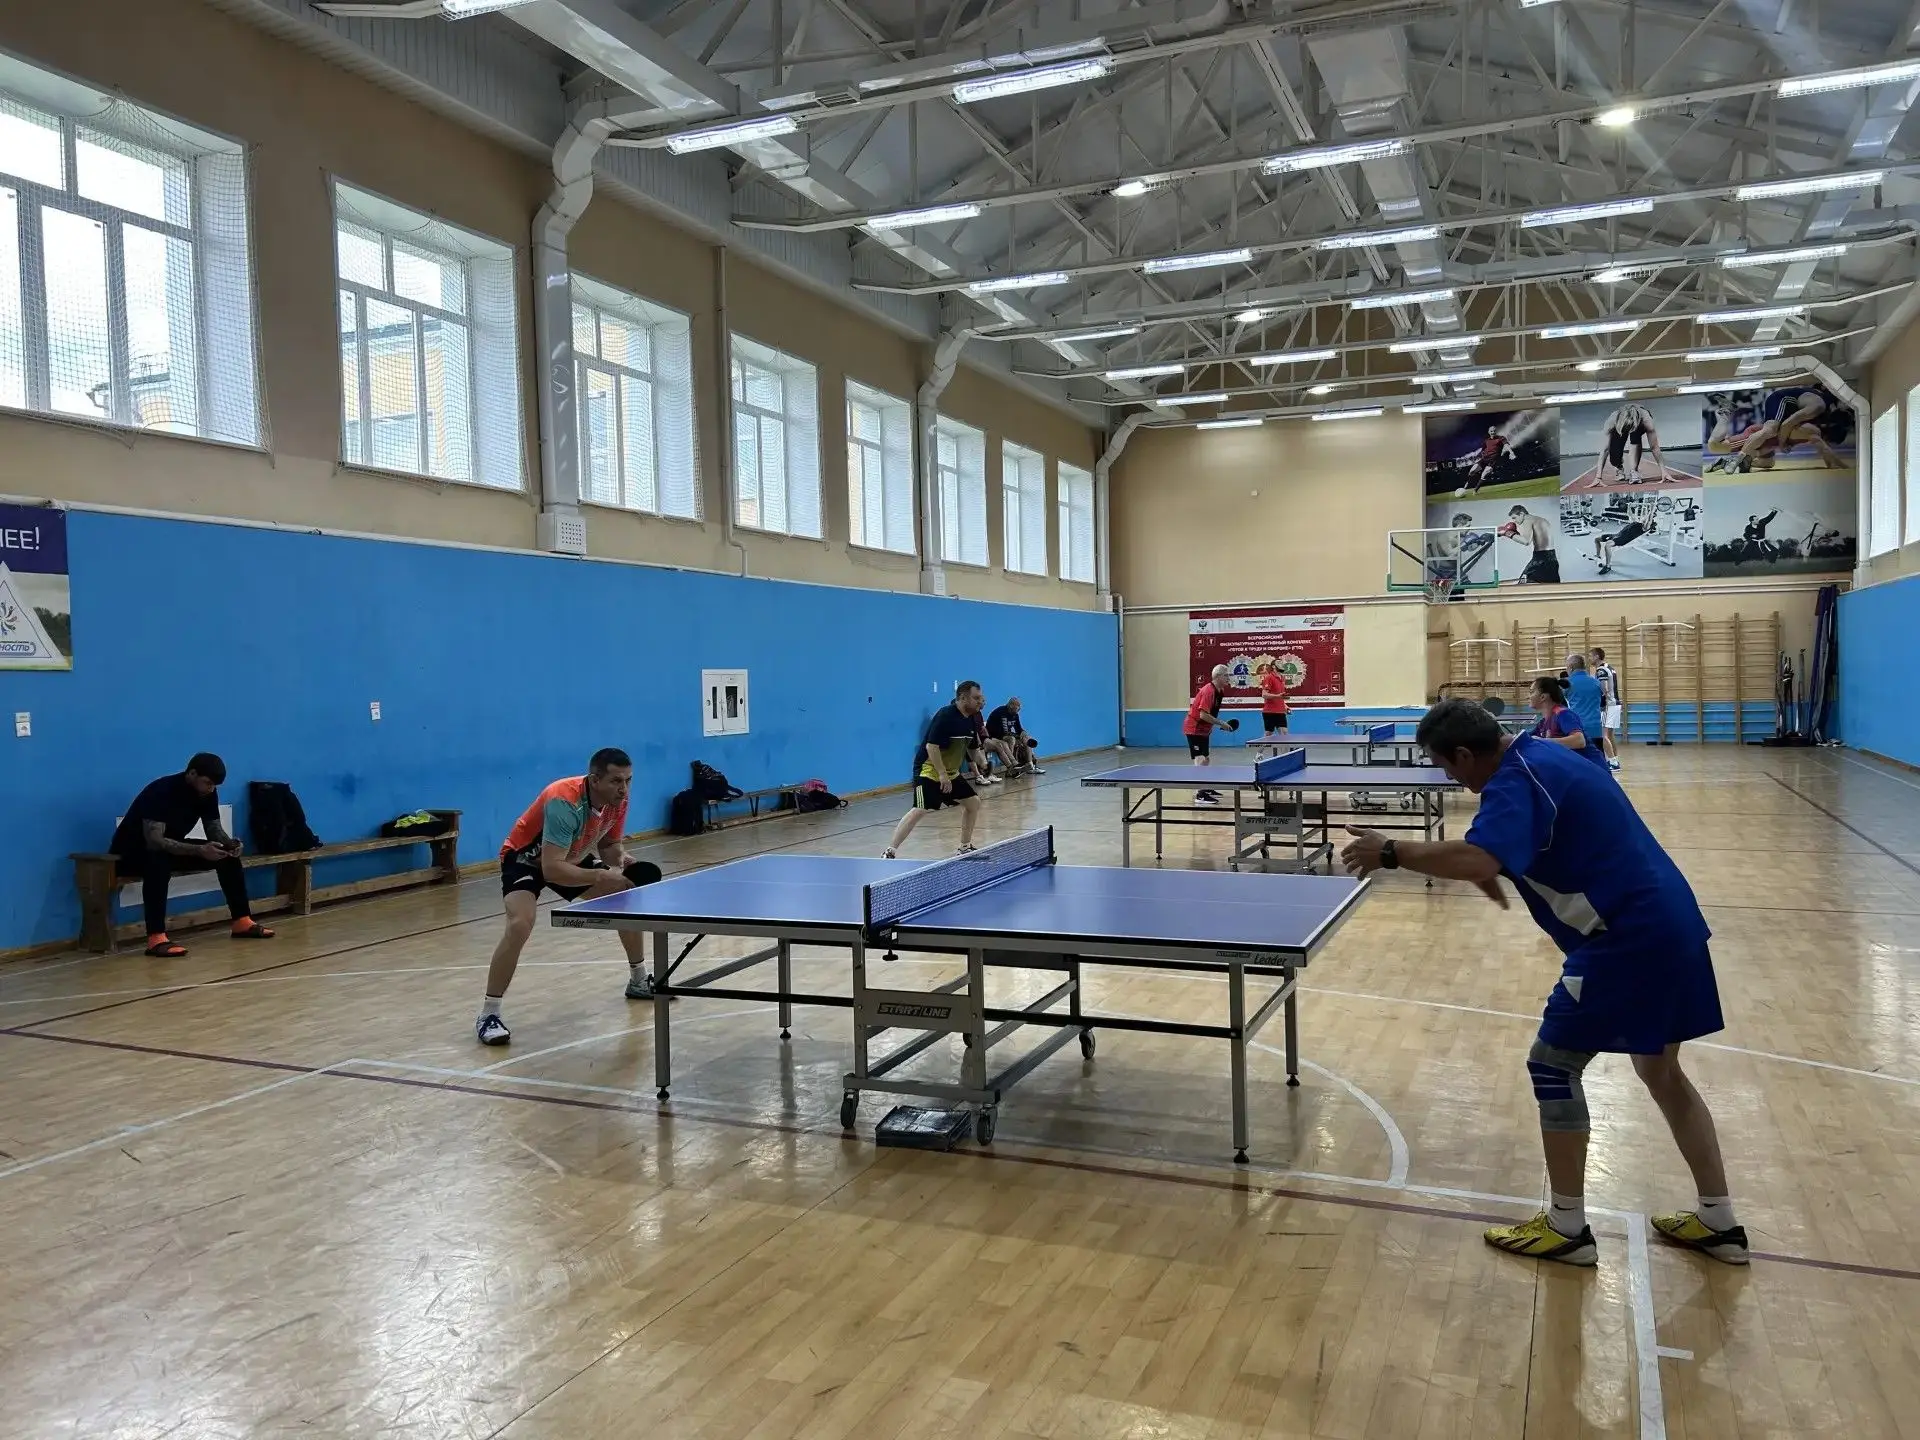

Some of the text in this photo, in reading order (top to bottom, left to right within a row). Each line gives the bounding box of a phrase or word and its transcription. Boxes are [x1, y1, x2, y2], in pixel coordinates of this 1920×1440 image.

[0, 526, 40, 550] ЕЕ!
[1273, 817, 1291, 825] LINE
[1254, 952, 1287, 966] Leader
[880, 1004, 949, 1018] START LINE
